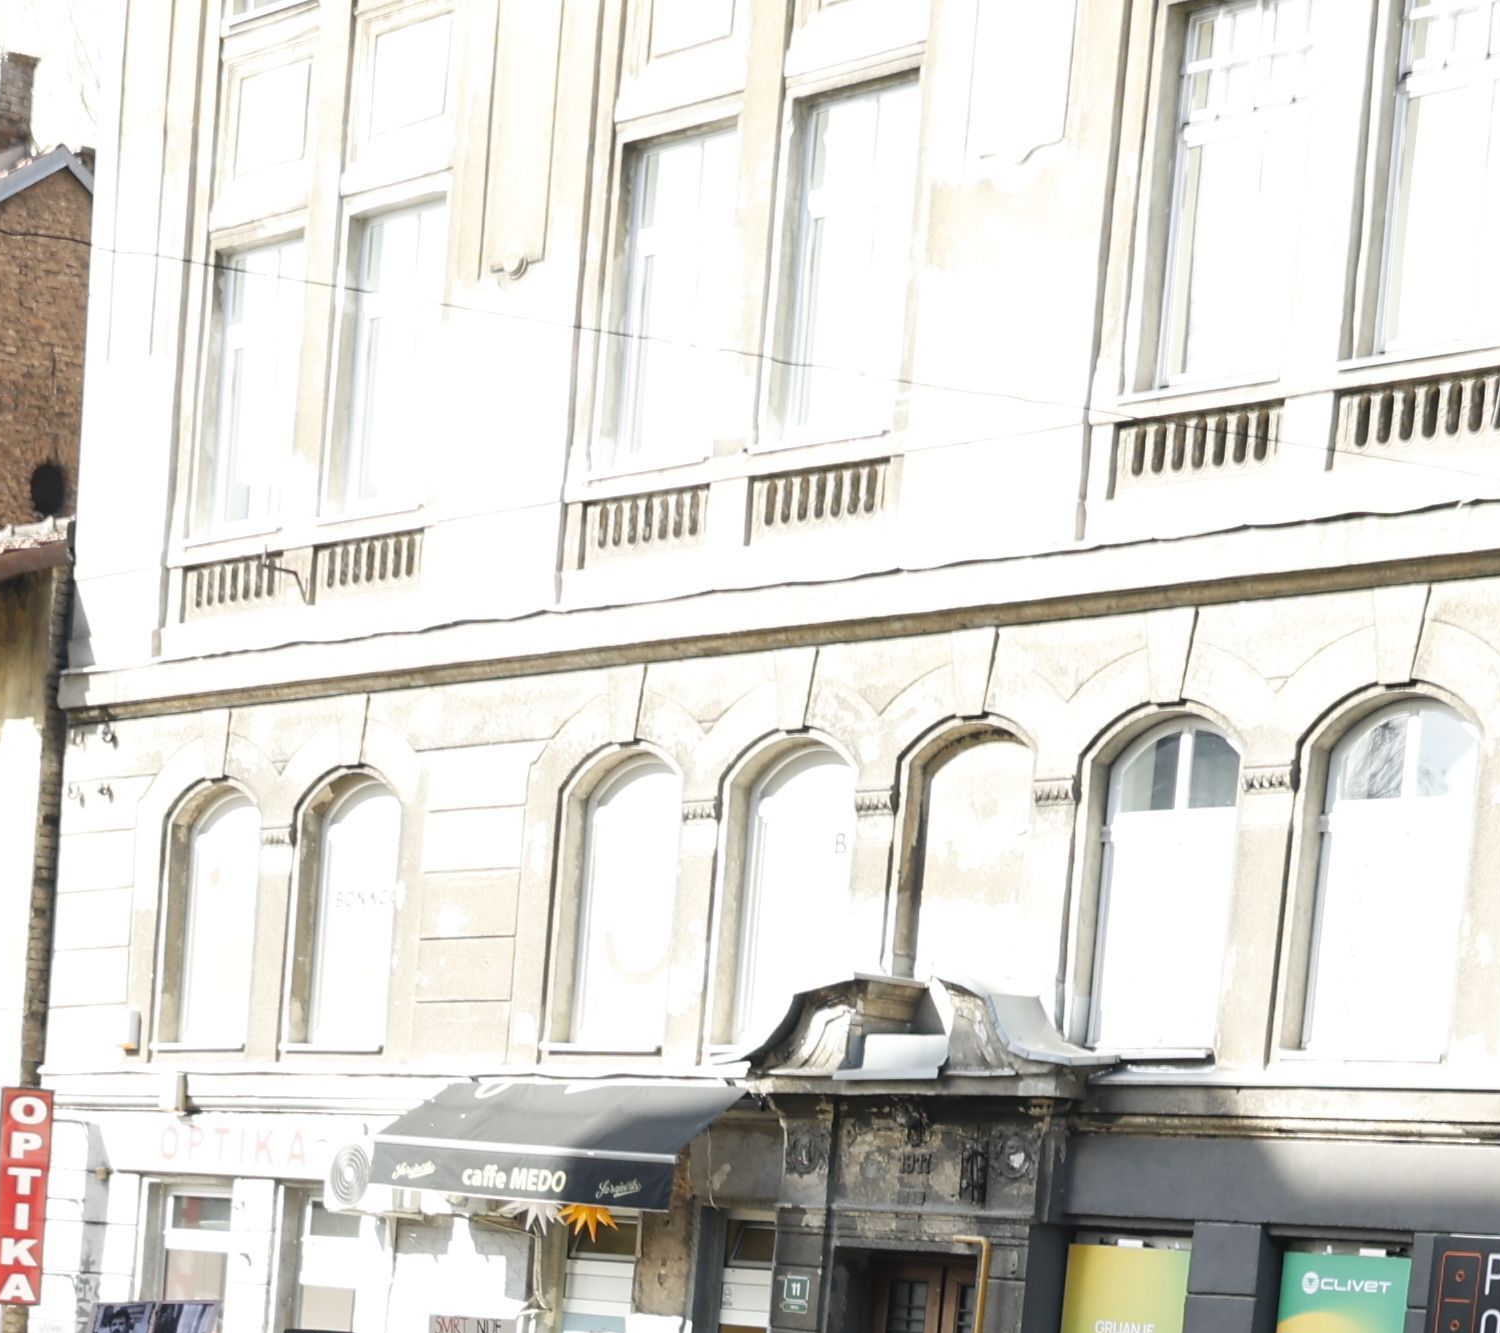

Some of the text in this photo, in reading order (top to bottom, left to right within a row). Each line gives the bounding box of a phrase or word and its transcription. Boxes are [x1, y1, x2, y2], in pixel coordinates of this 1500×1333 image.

[160, 1125, 306, 1167] OPTIKA
[462, 1164, 567, 1193] caffe MEDO
[791, 1282, 801, 1296] 11
